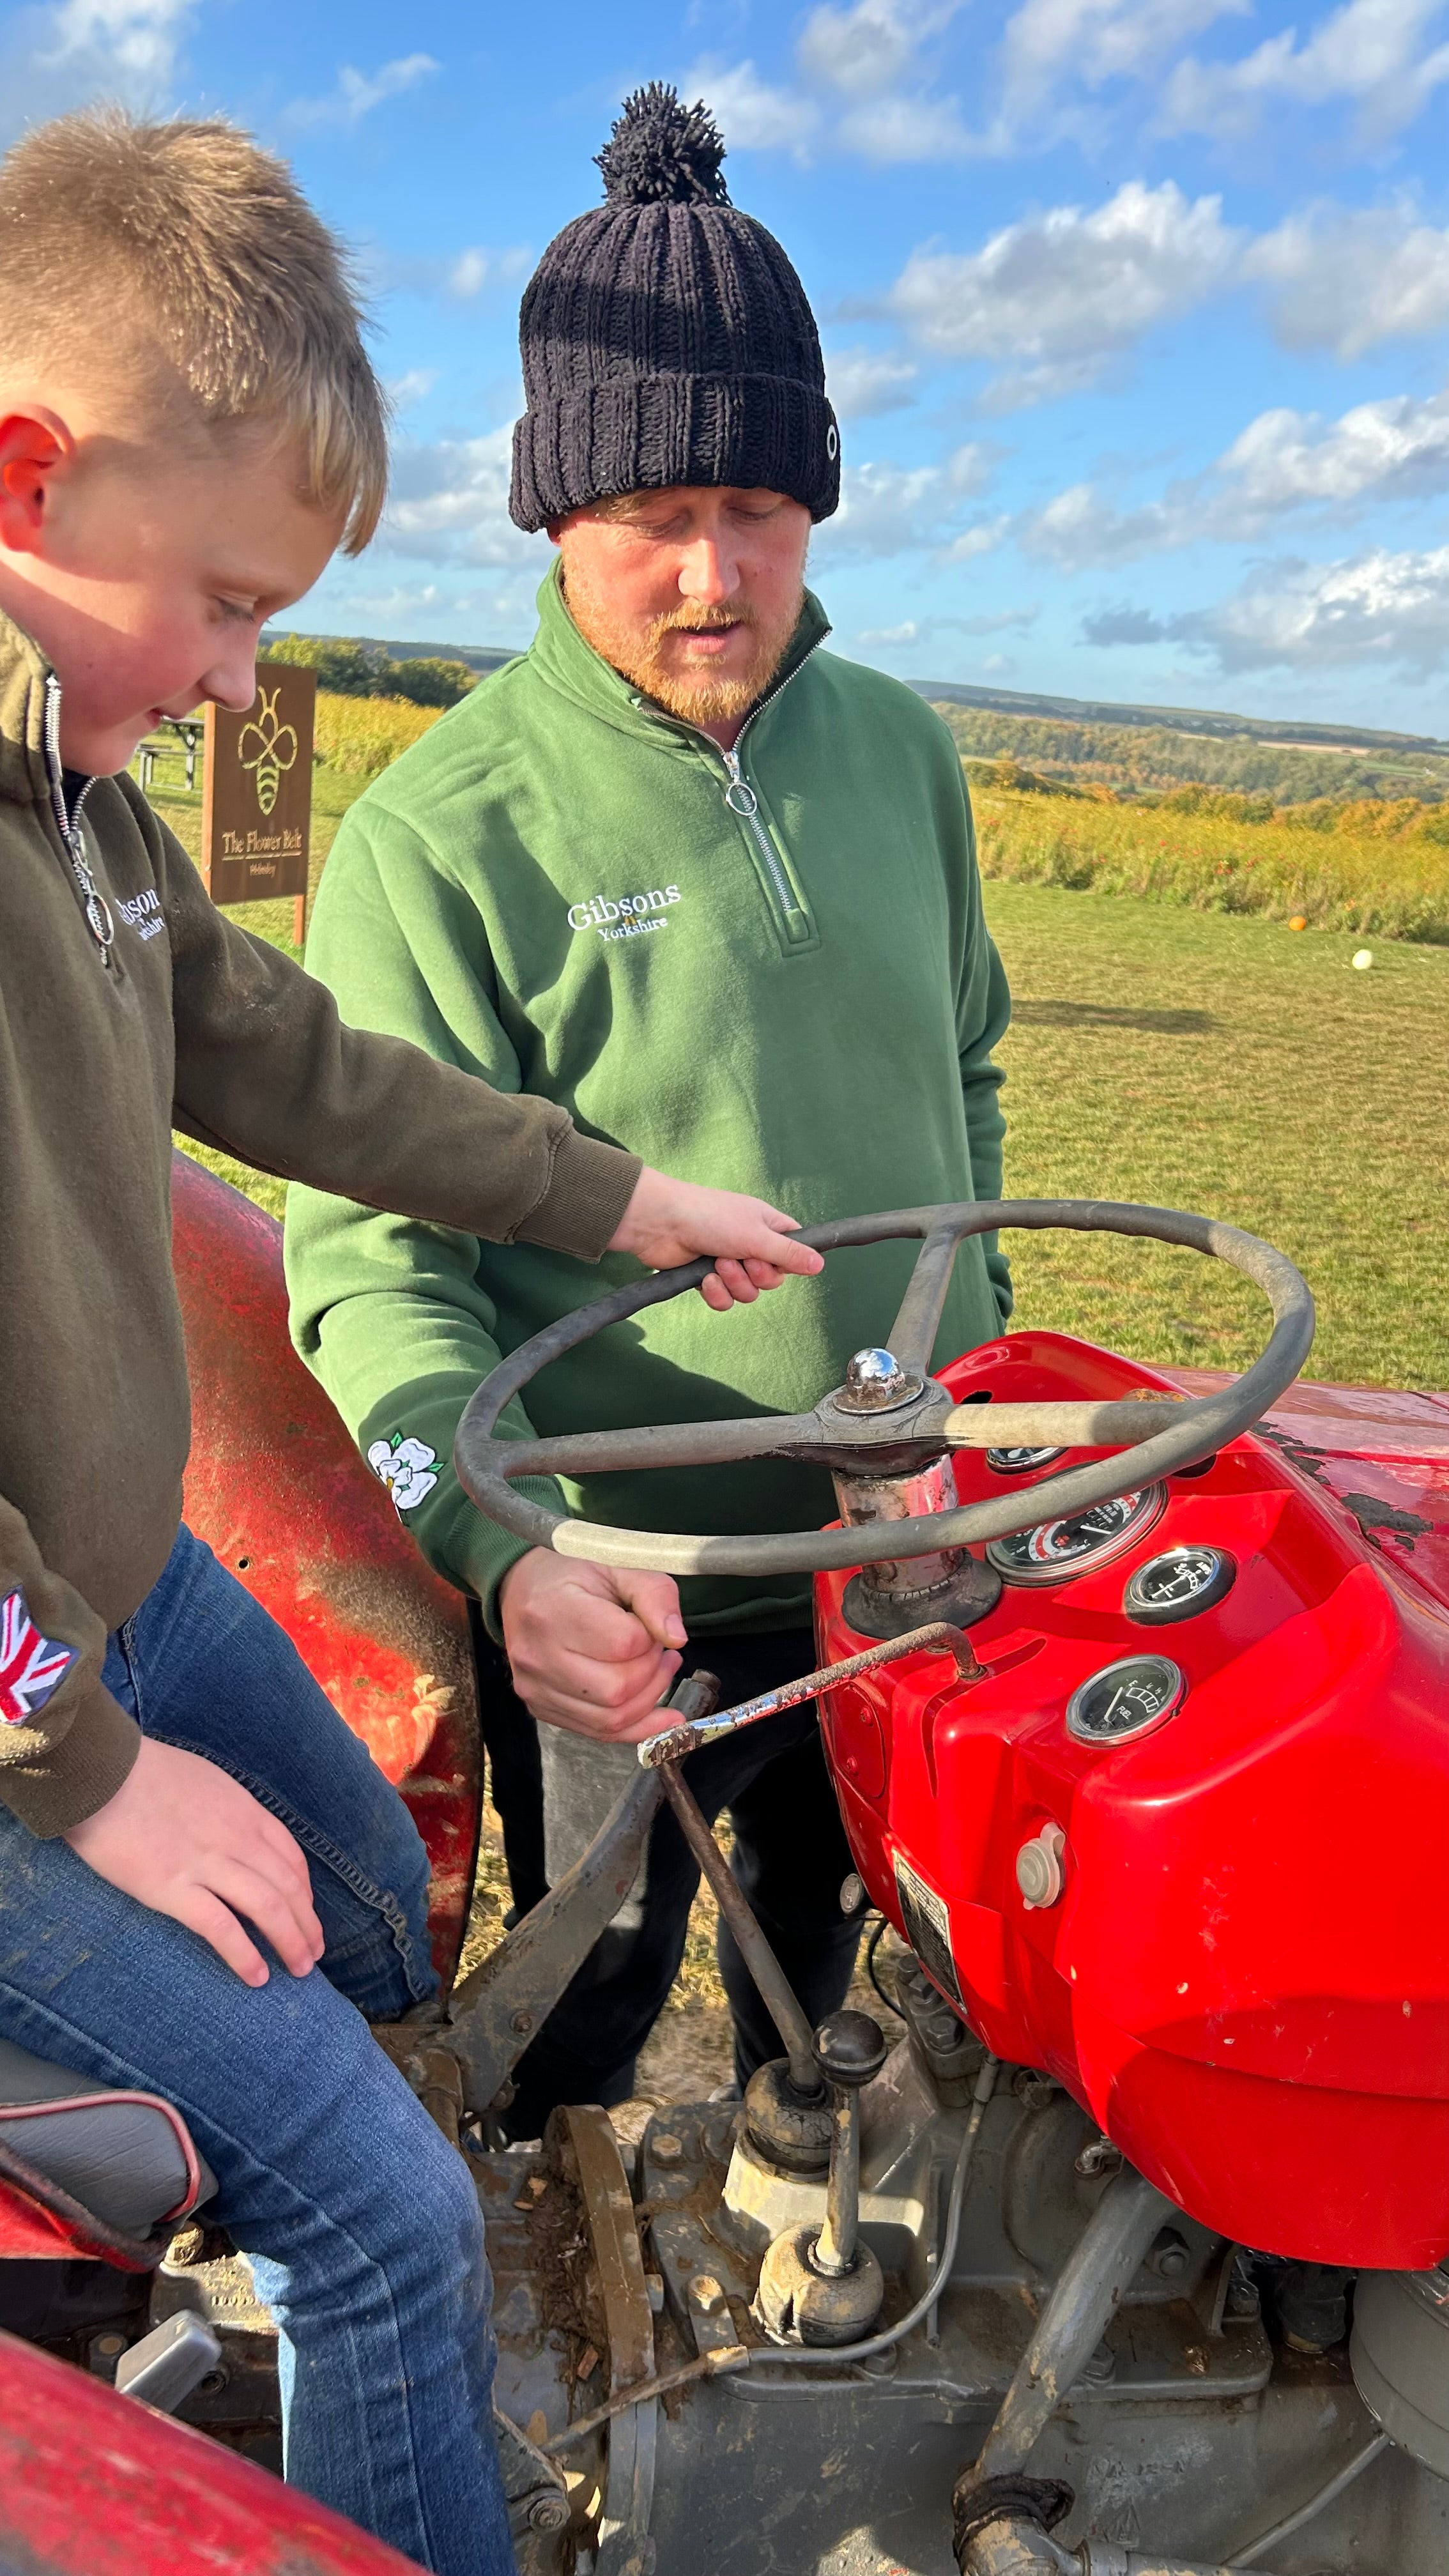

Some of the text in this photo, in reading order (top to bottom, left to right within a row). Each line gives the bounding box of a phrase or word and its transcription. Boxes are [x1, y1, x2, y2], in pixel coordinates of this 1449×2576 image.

[222, 827, 303, 854] The Flower Belt
[567, 884, 682, 931] Gibsons
[597, 917, 668, 942] Yorkshire
[1116, 1705, 1133, 1720] FUEL
